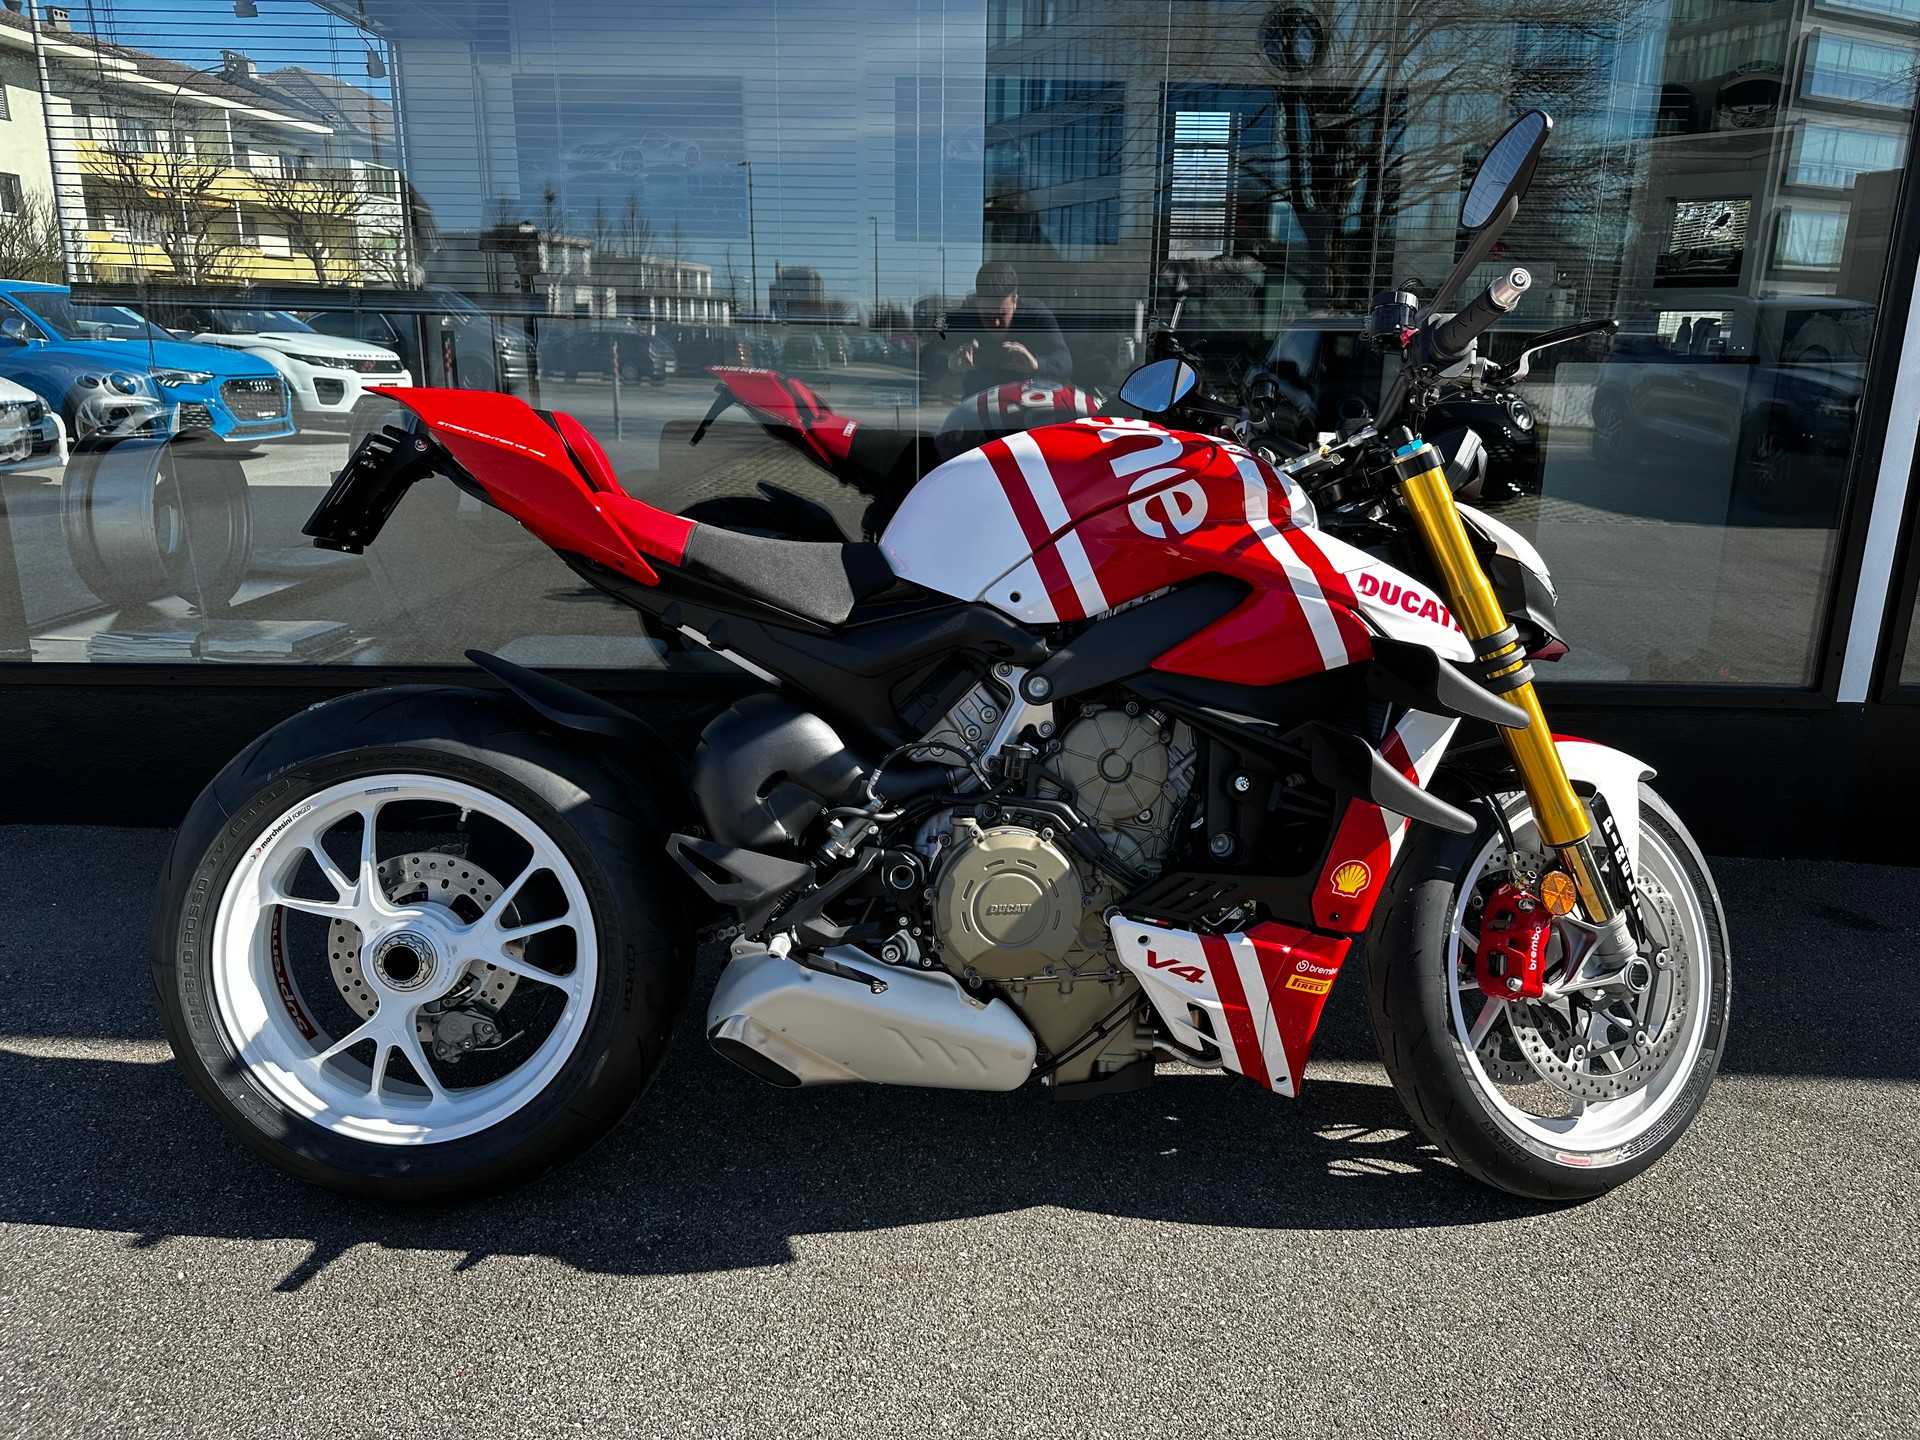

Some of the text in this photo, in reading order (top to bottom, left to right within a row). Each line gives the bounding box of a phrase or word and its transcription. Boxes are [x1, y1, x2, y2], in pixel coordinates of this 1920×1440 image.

[260, 815, 293, 849] marchesini
[1602, 815, 1643, 921] PIRELLI
[987, 903, 1032, 916] DUCATI
[1147, 949, 1206, 984] V4
[1528, 926, 1542, 970] brembo
[273, 912, 309, 1032] Supreme
